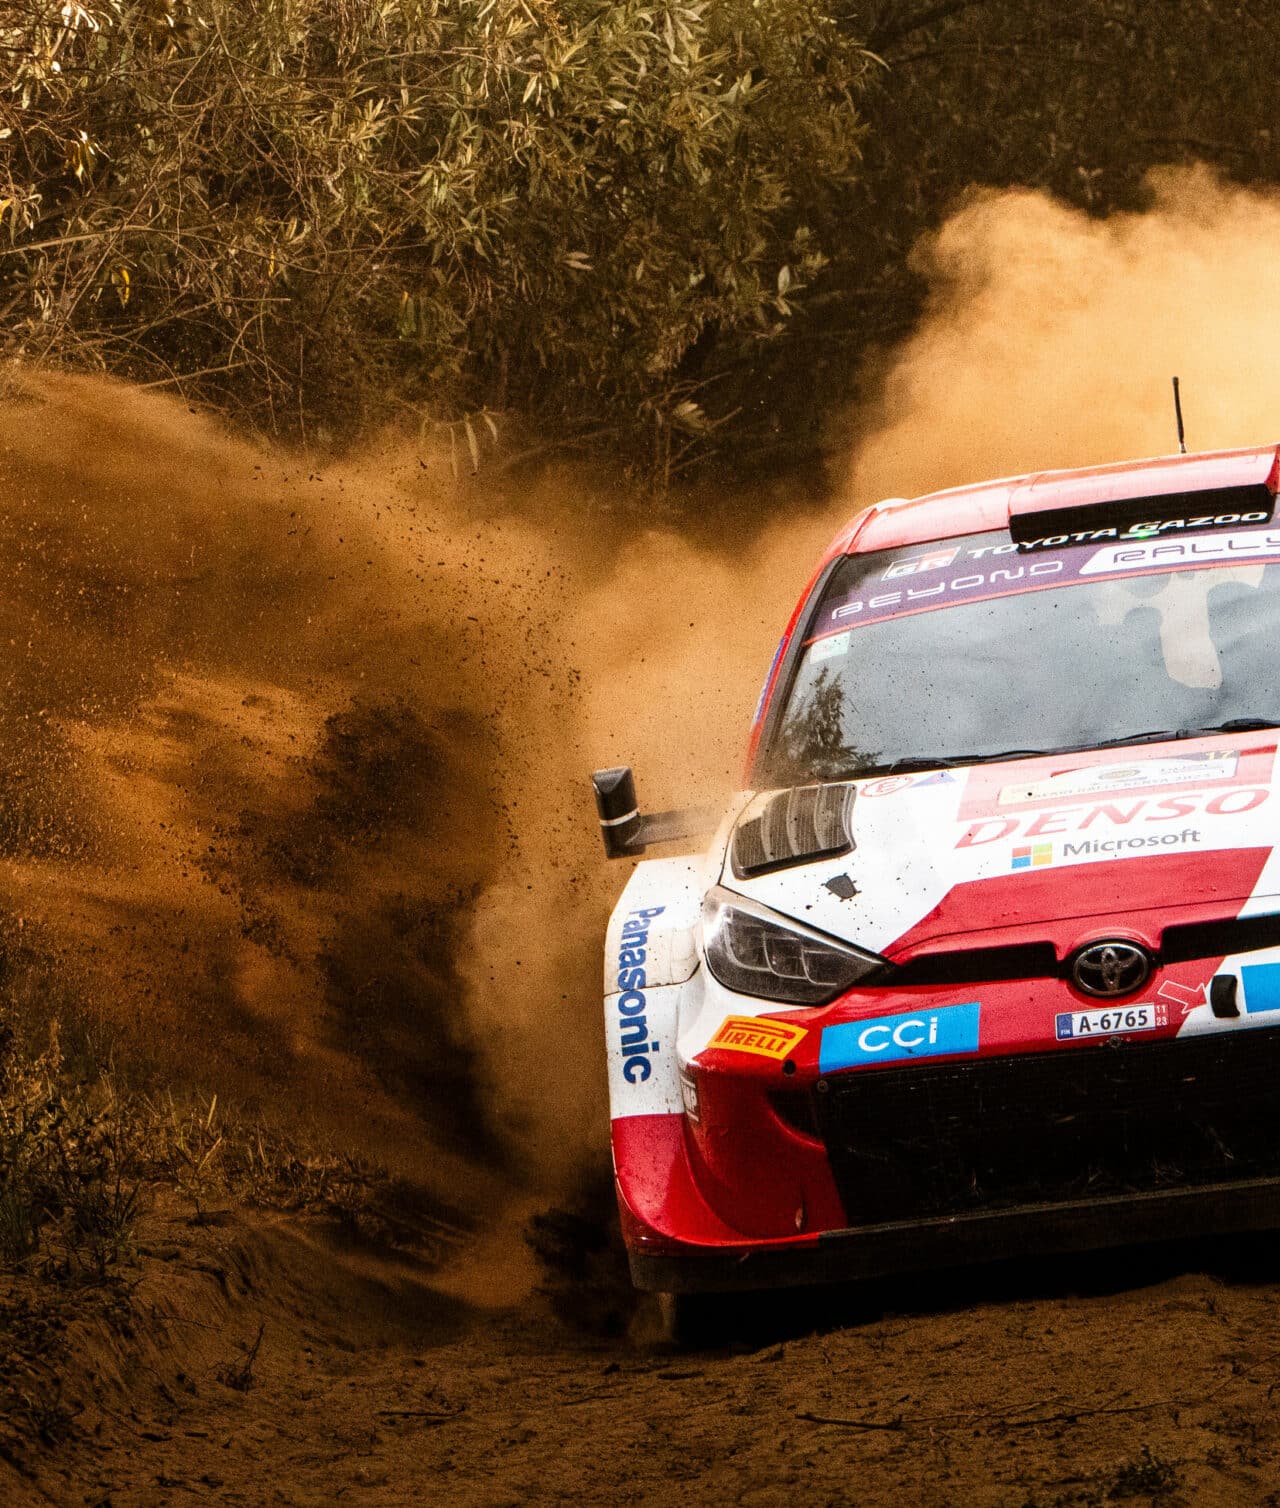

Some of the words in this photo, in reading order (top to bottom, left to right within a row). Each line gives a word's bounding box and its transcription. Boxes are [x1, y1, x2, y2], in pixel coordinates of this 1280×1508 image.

[968, 528, 1117, 559] TOYOTA
[1127, 511, 1268, 536] GAZOO
[831, 560, 1063, 620] BEYOND
[1205, 750, 1235, 760] 17
[954, 789, 1270, 849] DENSO
[1063, 829, 1201, 856] Microsoft
[618, 906, 666, 1084] Panasonic
[1156, 1004, 1166, 1014] 11
[1079, 1009, 1148, 1033] A-6765
[1156, 1017, 1168, 1027] 23
[715, 1020, 797, 1053] PIRELLI
